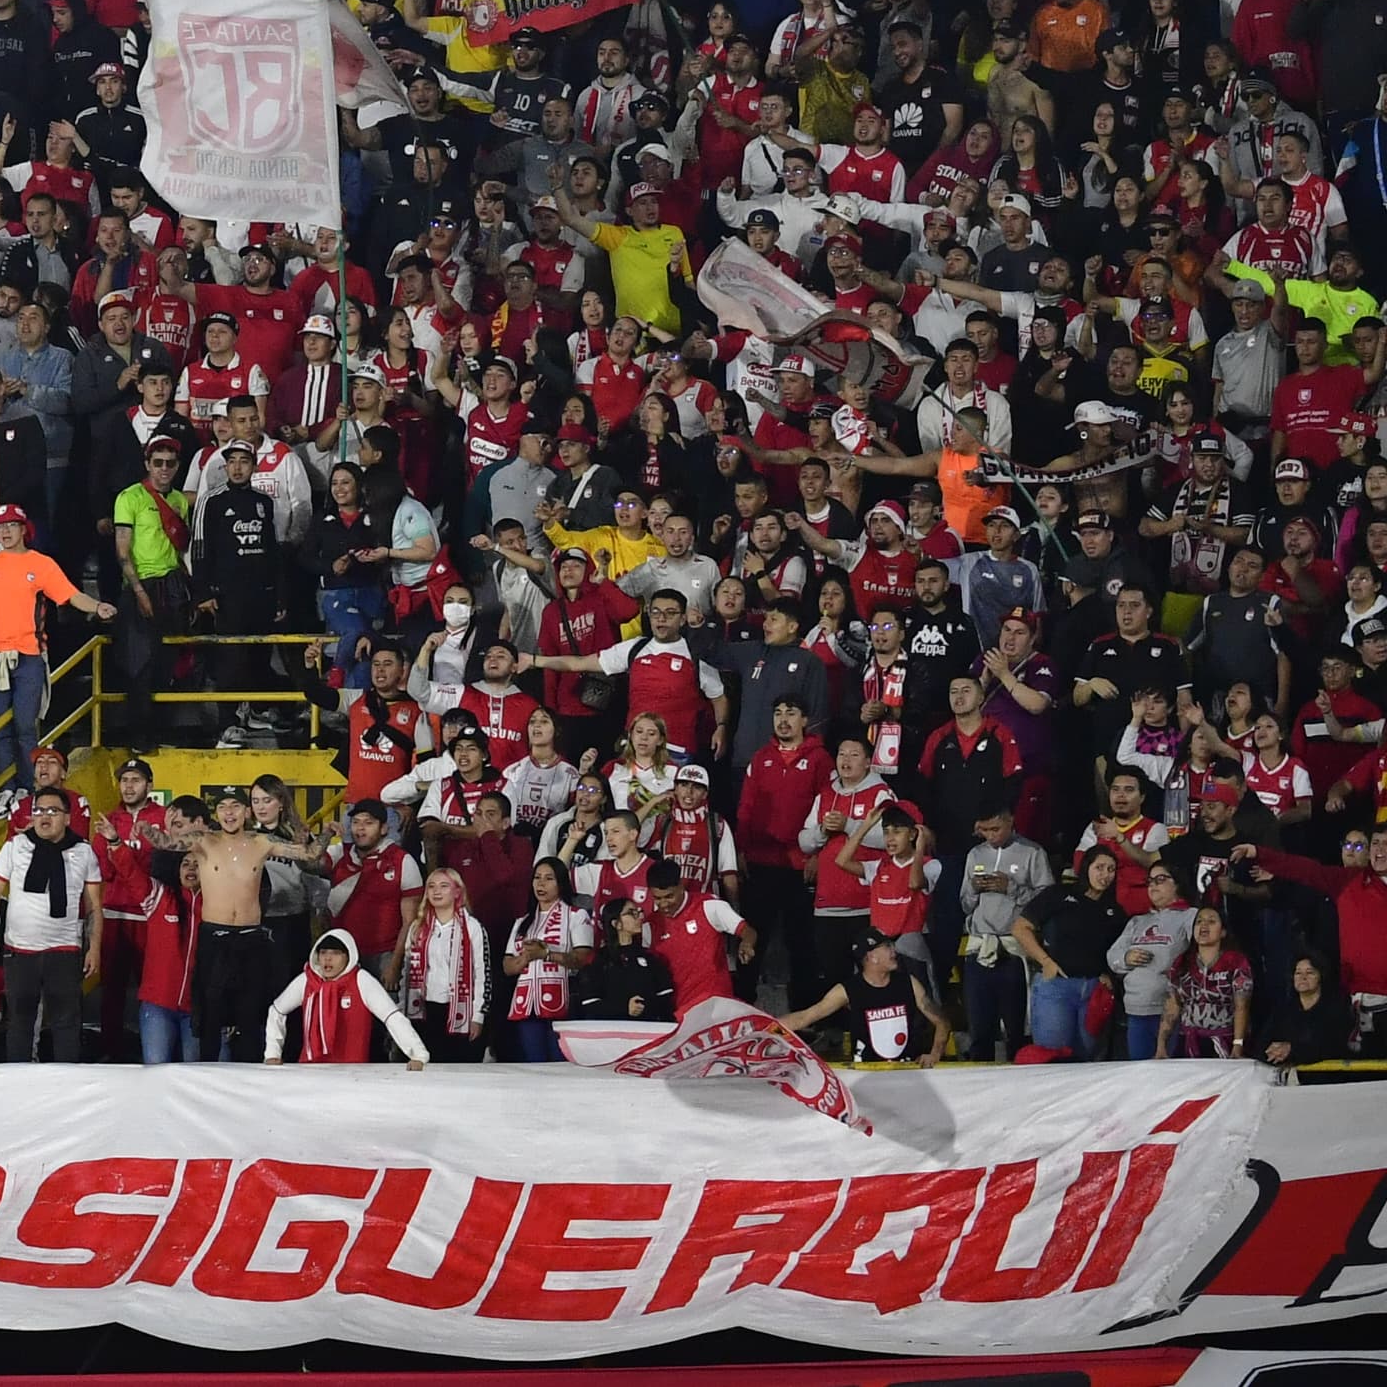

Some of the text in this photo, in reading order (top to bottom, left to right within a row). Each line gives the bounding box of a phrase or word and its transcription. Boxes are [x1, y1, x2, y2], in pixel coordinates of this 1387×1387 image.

[513, 93, 531, 112] 10
[739, 376, 779, 392] BetPlay
[471, 441, 505, 458] Colanta
[911, 641, 948, 656] Kappa
[867, 1005, 907, 1021] SANTA FE
[644, 1095, 1219, 1314] AQUÍ
